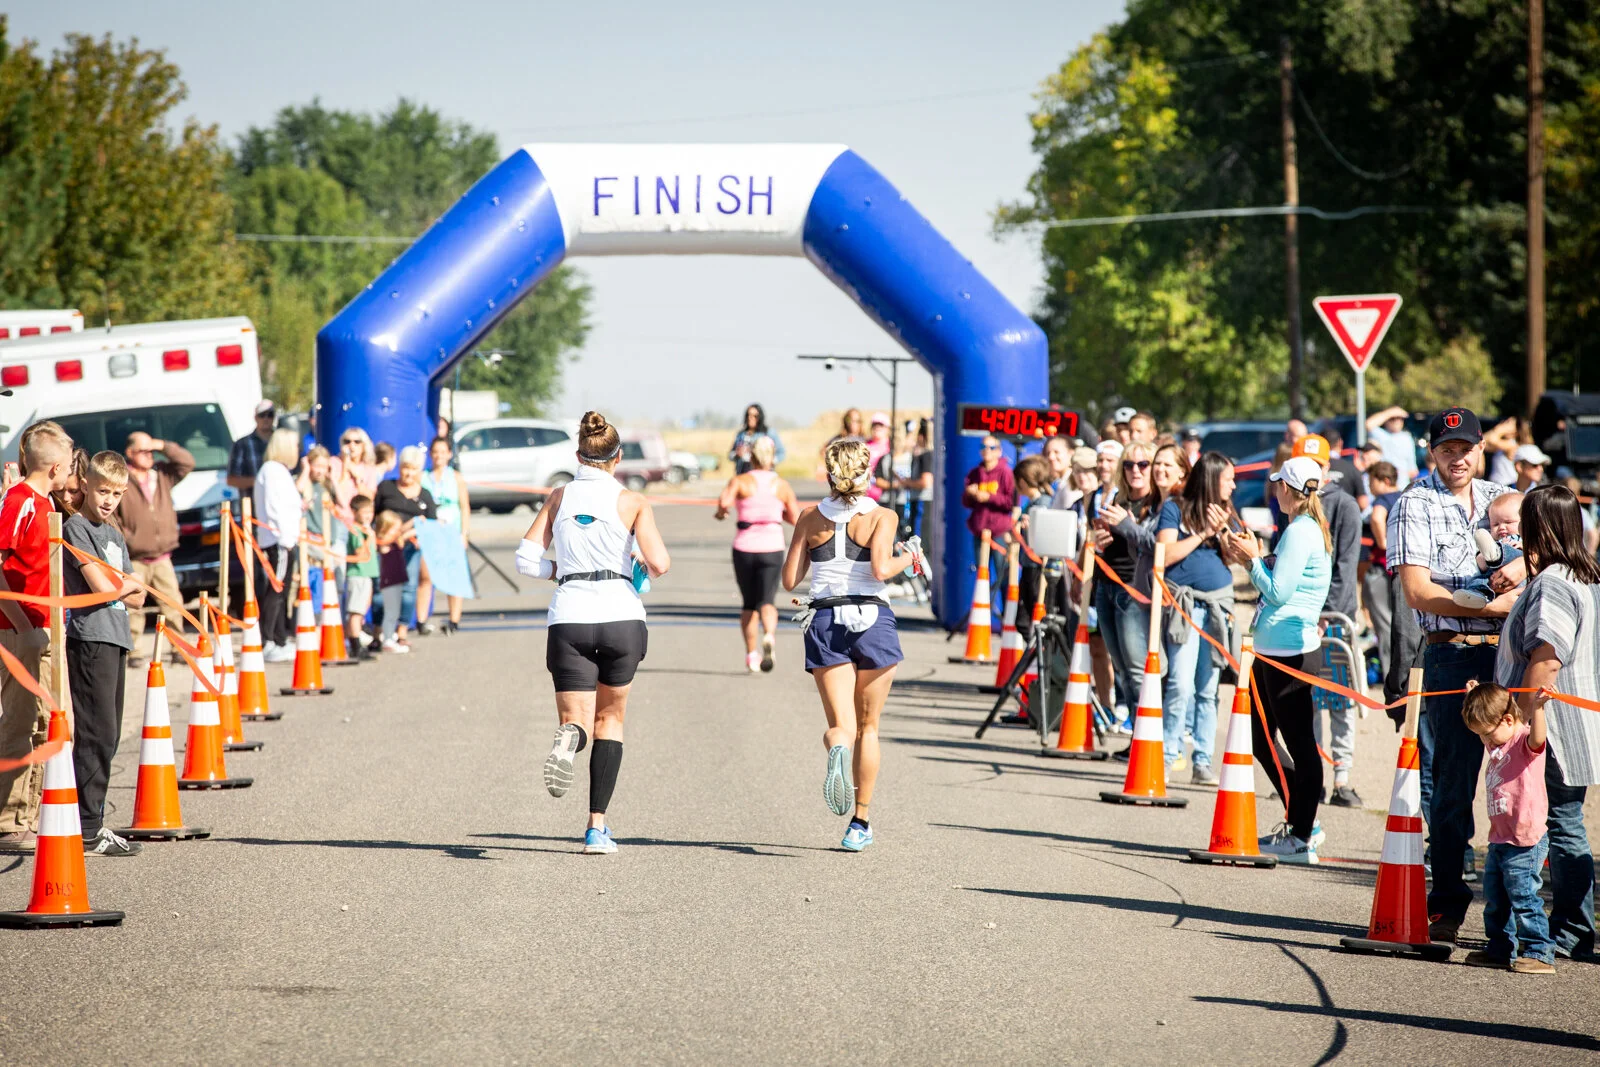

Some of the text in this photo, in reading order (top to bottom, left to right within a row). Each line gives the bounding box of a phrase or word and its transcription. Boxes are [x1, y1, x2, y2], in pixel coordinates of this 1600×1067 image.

[593, 174, 773, 216] FINISH
[981, 409, 1079, 437] 4:00:27
[1447, 415, 1459, 427] U
[45, 881, 75, 897] BHS
[1374, 921, 1395, 935] BHS
